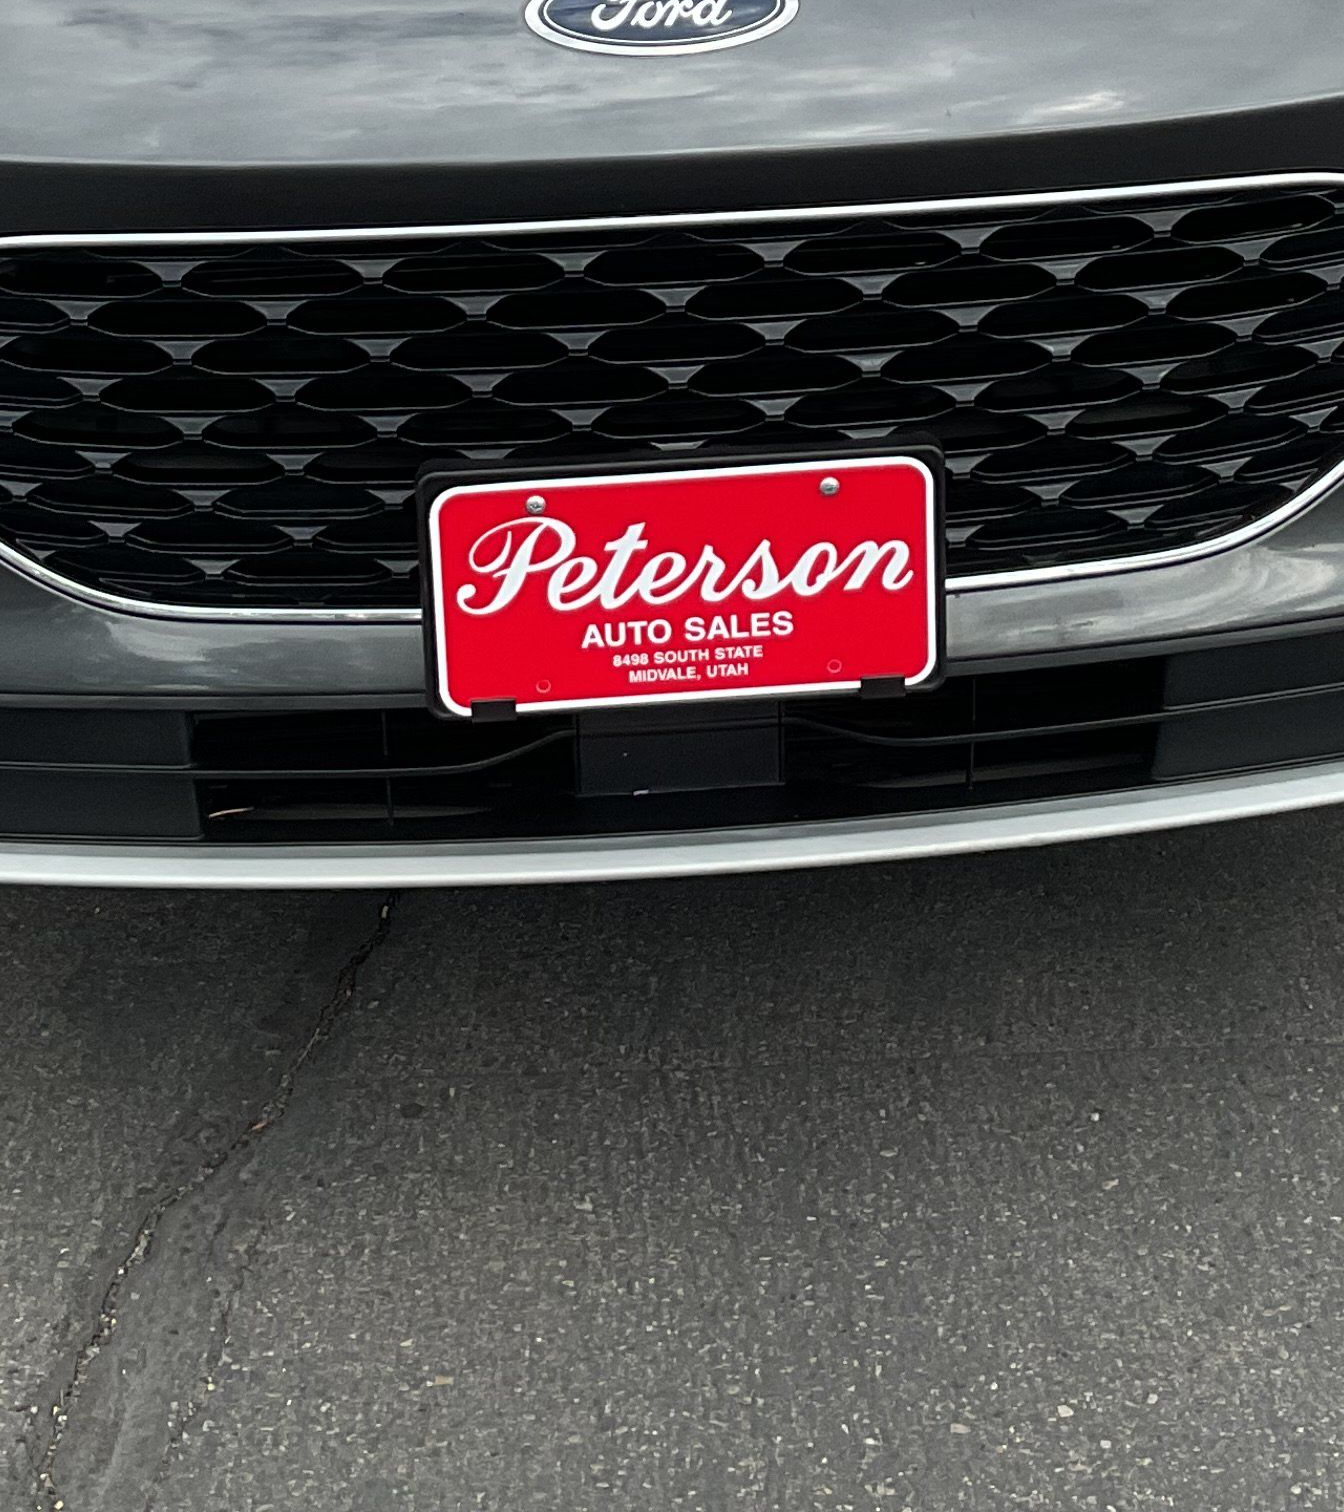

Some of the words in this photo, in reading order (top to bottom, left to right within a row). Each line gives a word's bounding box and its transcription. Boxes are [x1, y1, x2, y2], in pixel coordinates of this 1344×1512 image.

[456, 516, 914, 615] Peterson
[581, 619, 672, 648] AUTO
[684, 611, 794, 641] SALES
[612, 653, 649, 667] 8498
[653, 649, 710, 664] SOUTH
[714, 645, 763, 660] STATE
[629, 666, 701, 683] MIDVALE,
[706, 663, 749, 677] UTAH
